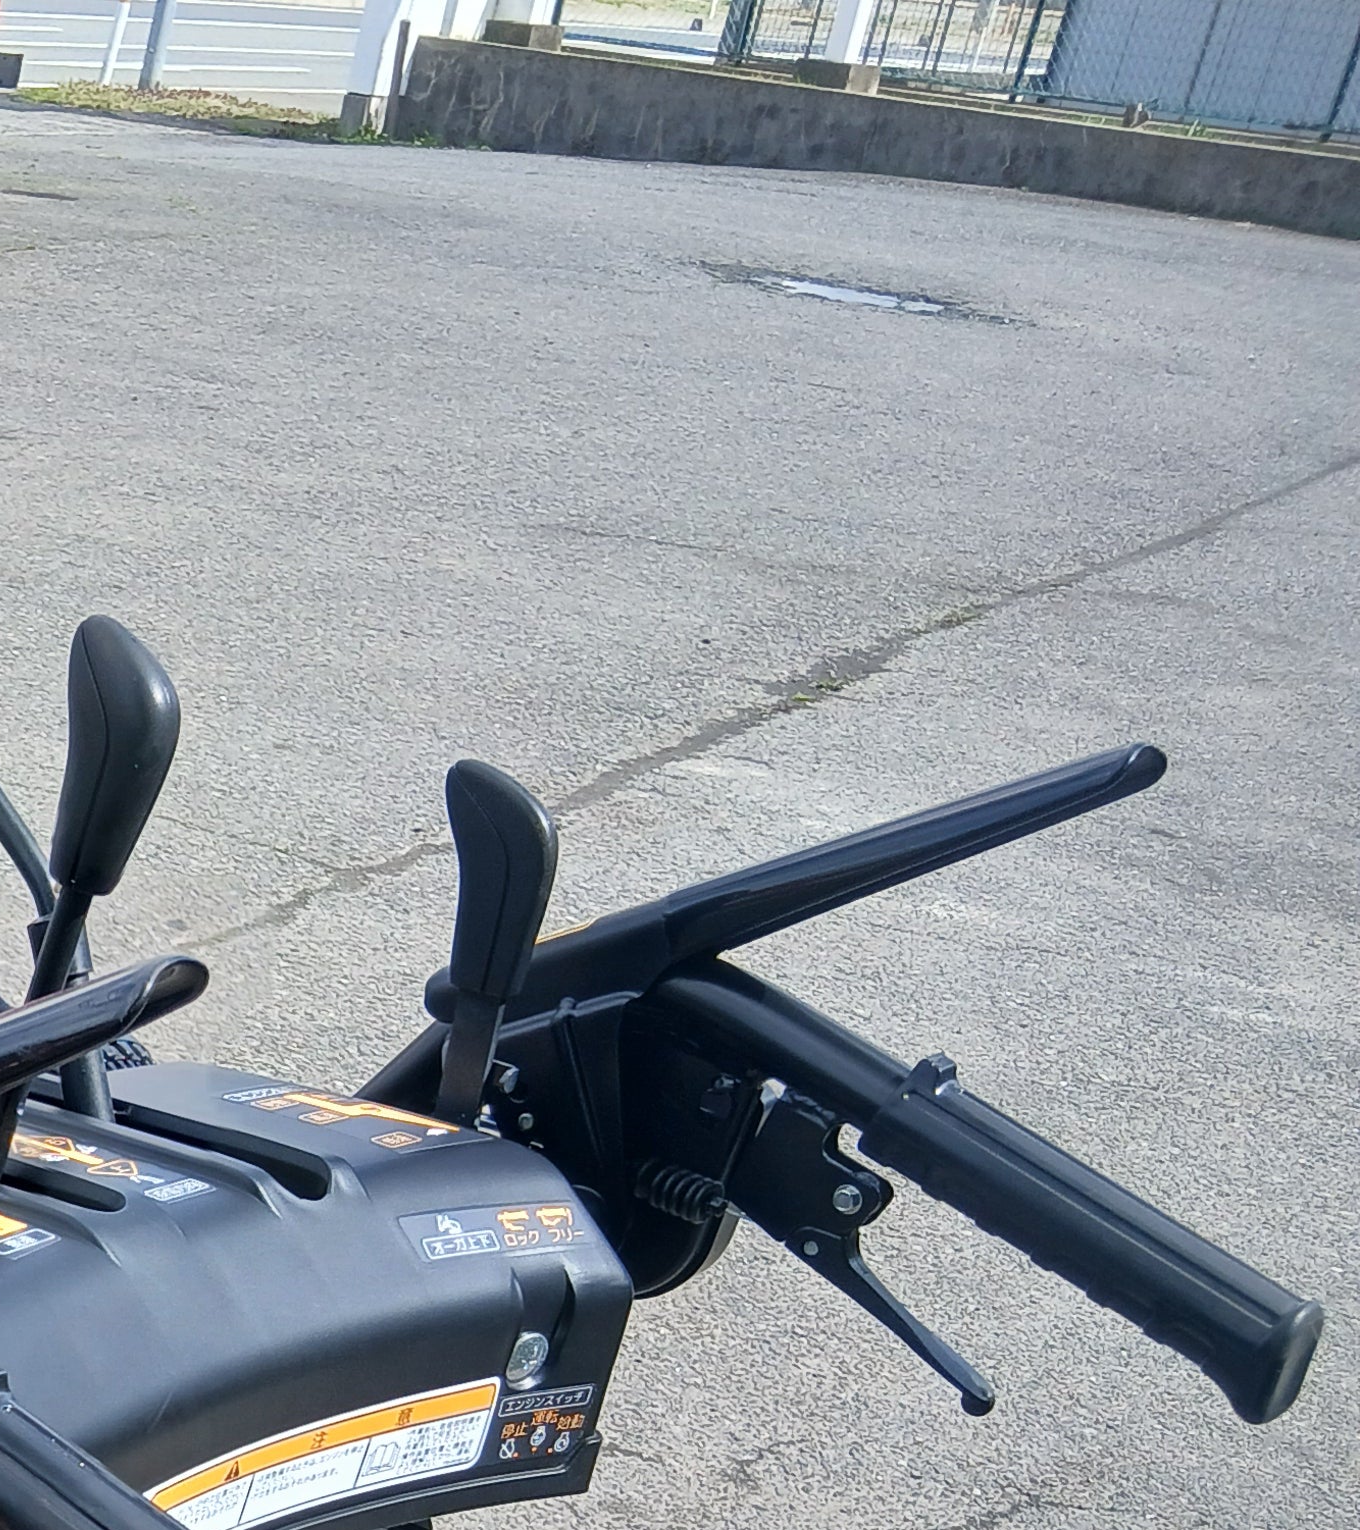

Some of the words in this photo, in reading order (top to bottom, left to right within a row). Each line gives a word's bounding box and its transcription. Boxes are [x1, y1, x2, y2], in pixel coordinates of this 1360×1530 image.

[502, 1229, 540, 1247] ロック
[546, 1226, 586, 1243] フリー
[504, 1391, 585, 1413] エンジンスイッチ
[530, 1408, 561, 1427] 運転
[500, 1421, 529, 1440] 停止
